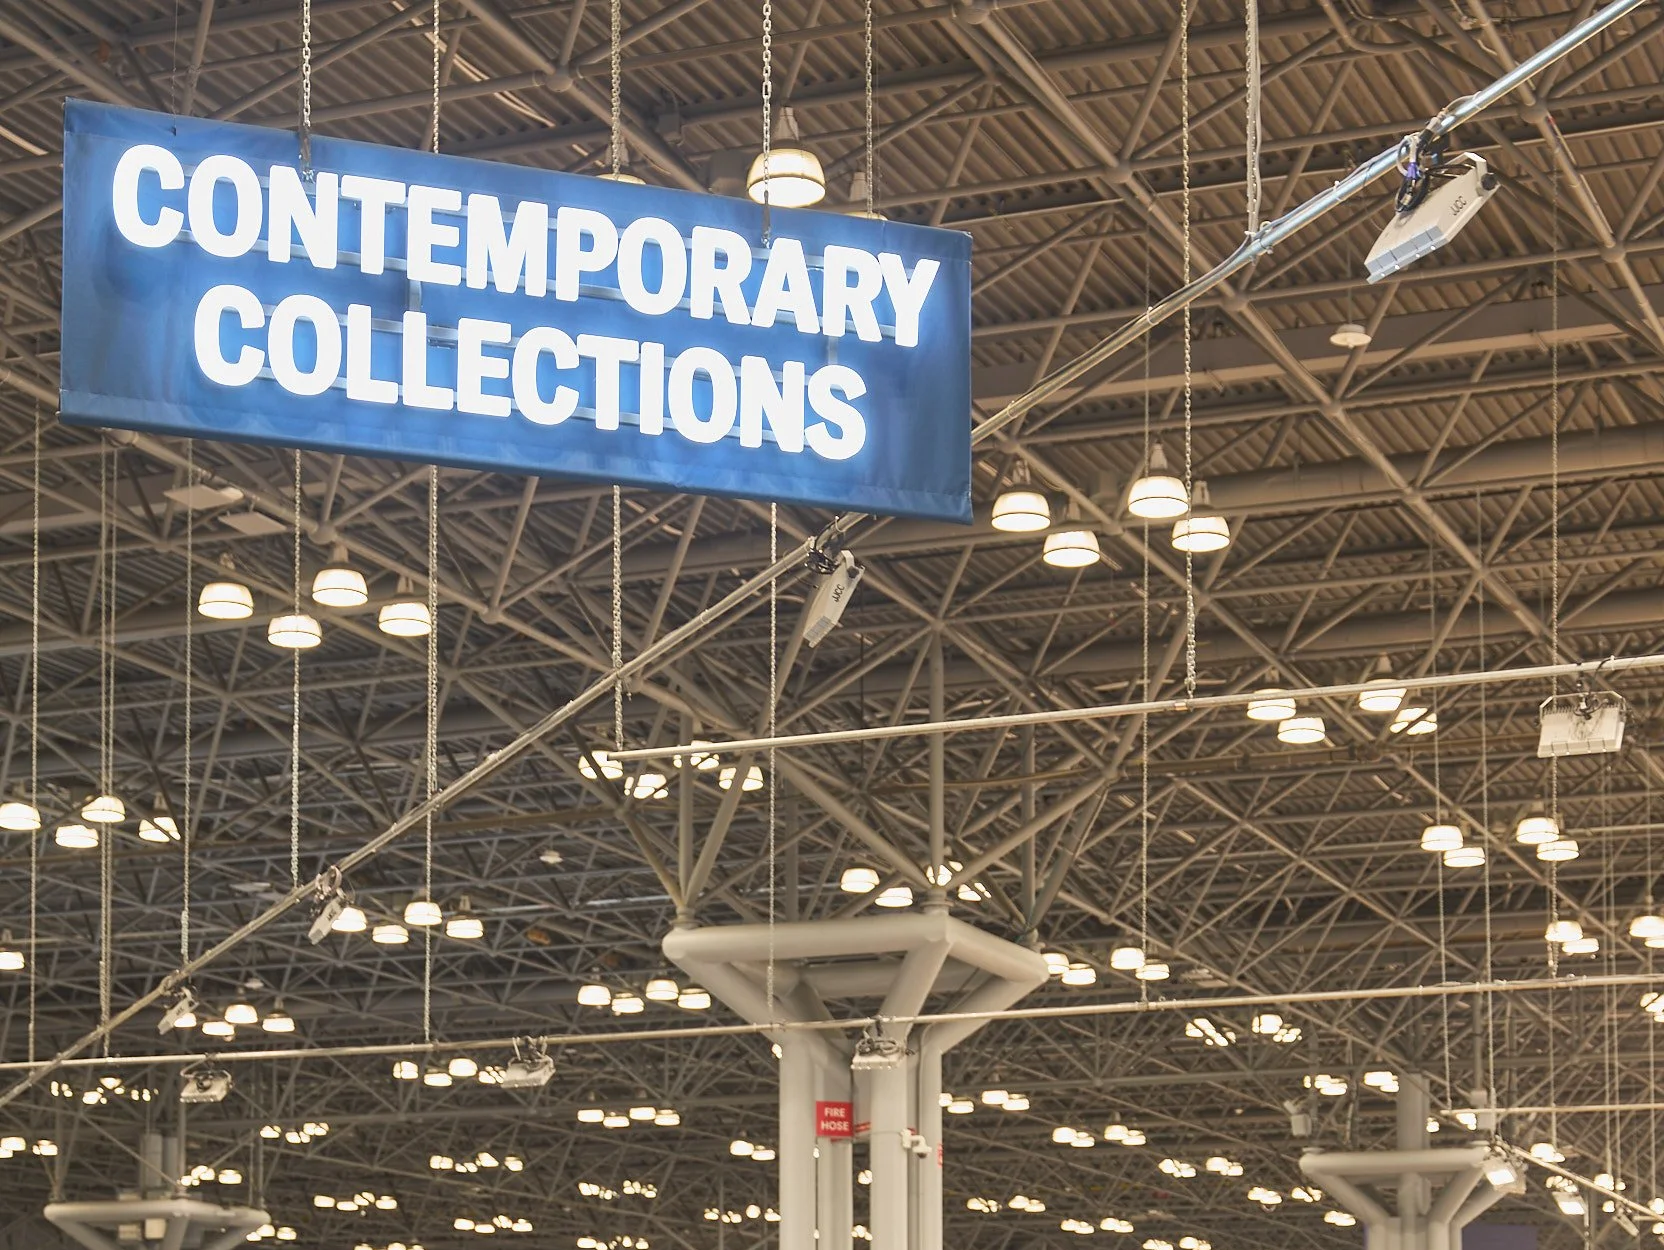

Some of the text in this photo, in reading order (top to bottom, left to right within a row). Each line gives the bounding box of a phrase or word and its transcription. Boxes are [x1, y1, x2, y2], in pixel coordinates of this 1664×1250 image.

[113, 144, 940, 348] CONTEMPORARY
[194, 284, 867, 460] COLLECTIONS
[820, 1121, 849, 1131] HOSE
[824, 1107, 845, 1117] FIRE
